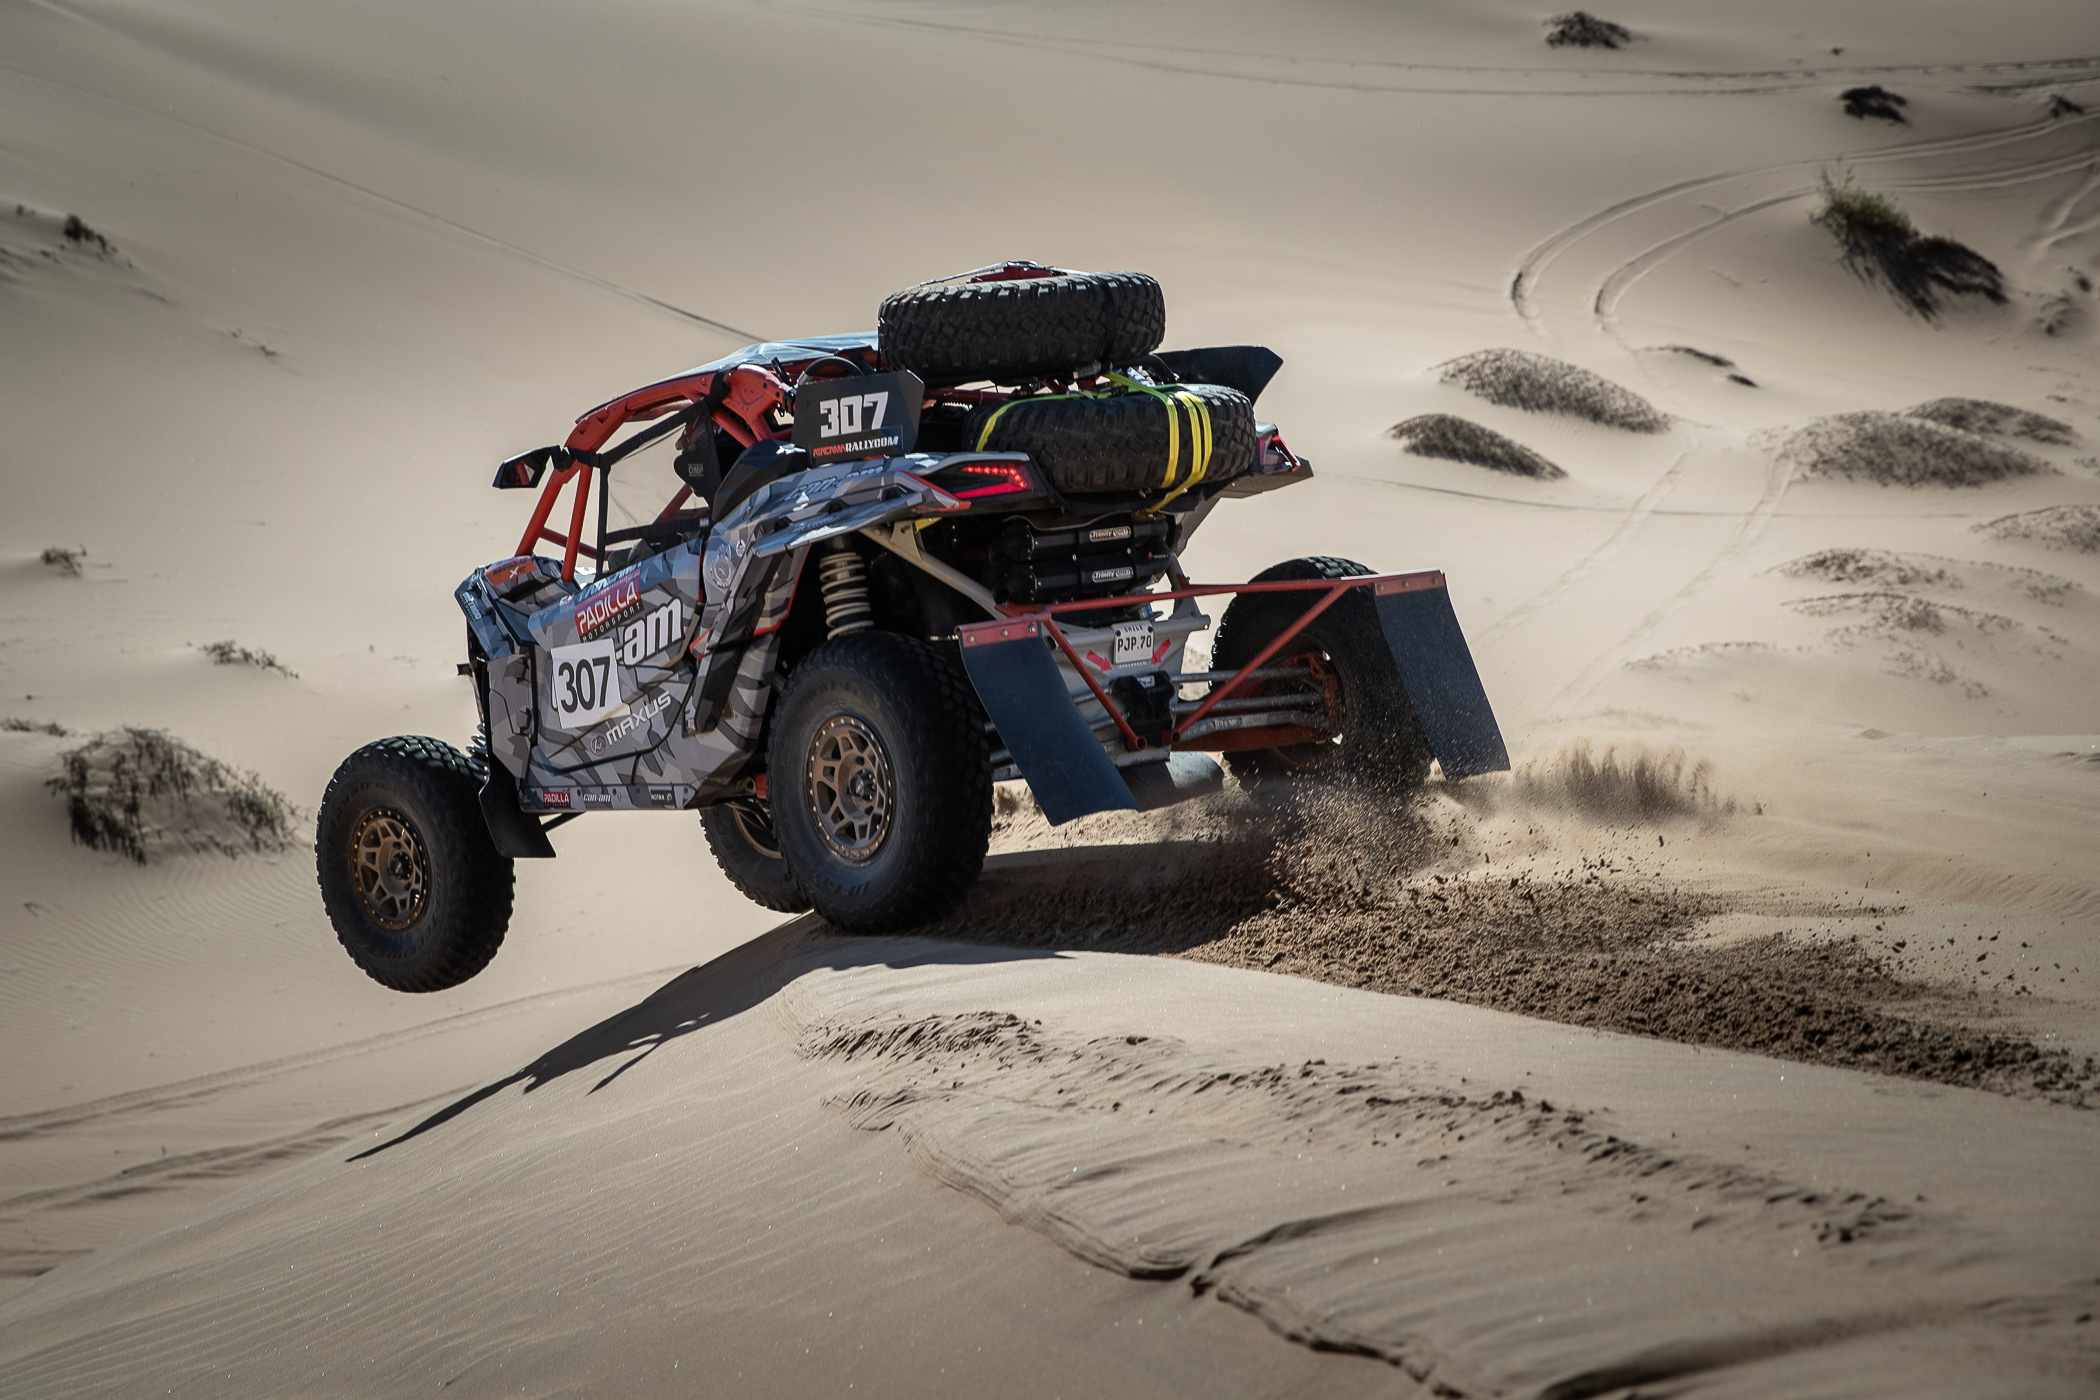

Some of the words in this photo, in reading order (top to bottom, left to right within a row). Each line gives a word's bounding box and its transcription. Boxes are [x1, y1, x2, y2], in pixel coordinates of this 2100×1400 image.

[820, 391, 888, 438] 307
[688, 465, 704, 475] OMP
[577, 581, 638, 634] PADILLA
[582, 602, 641, 643] MOTORSPORT
[558, 656, 611, 713] 307
[606, 690, 671, 746] MAXUS
[543, 793, 570, 804] PADILLA
[583, 793, 611, 803] can-am
